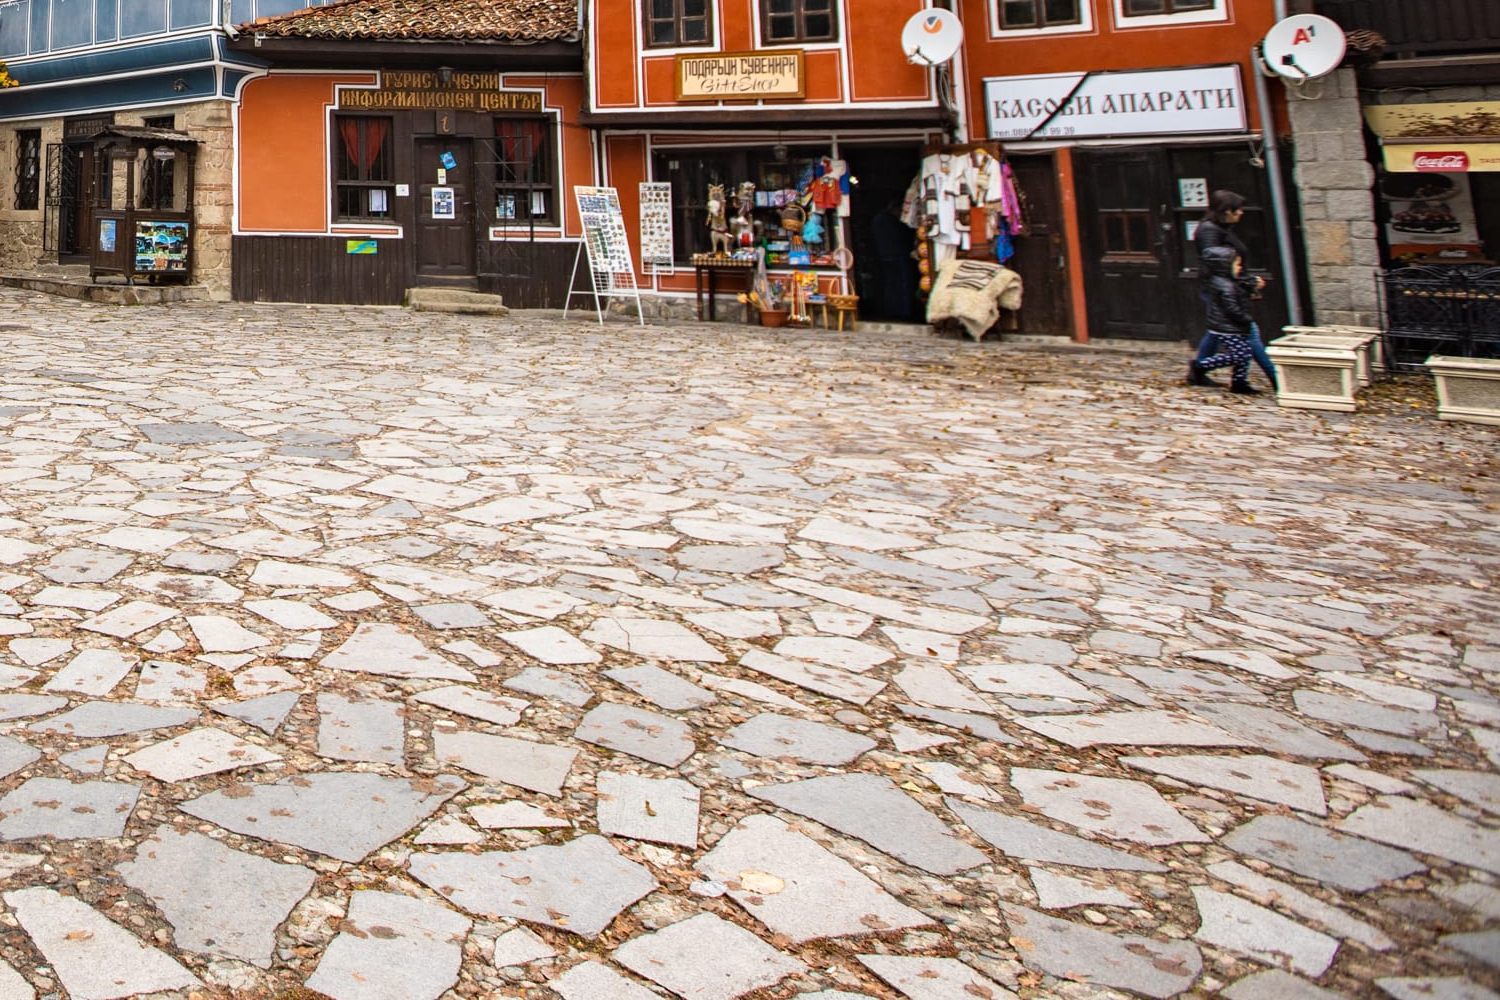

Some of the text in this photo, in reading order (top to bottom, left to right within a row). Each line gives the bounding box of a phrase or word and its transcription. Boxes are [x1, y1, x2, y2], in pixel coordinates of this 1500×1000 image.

[1292, 25, 1316, 46] A1
[740, 56, 796, 79] СУВЕНИРИ
[341, 90, 541, 111] ИНФОРМАЦИОНЕН ЦЕНТЪР
[993, 88, 1236, 119] КАСОВИ АПАРАТИ
